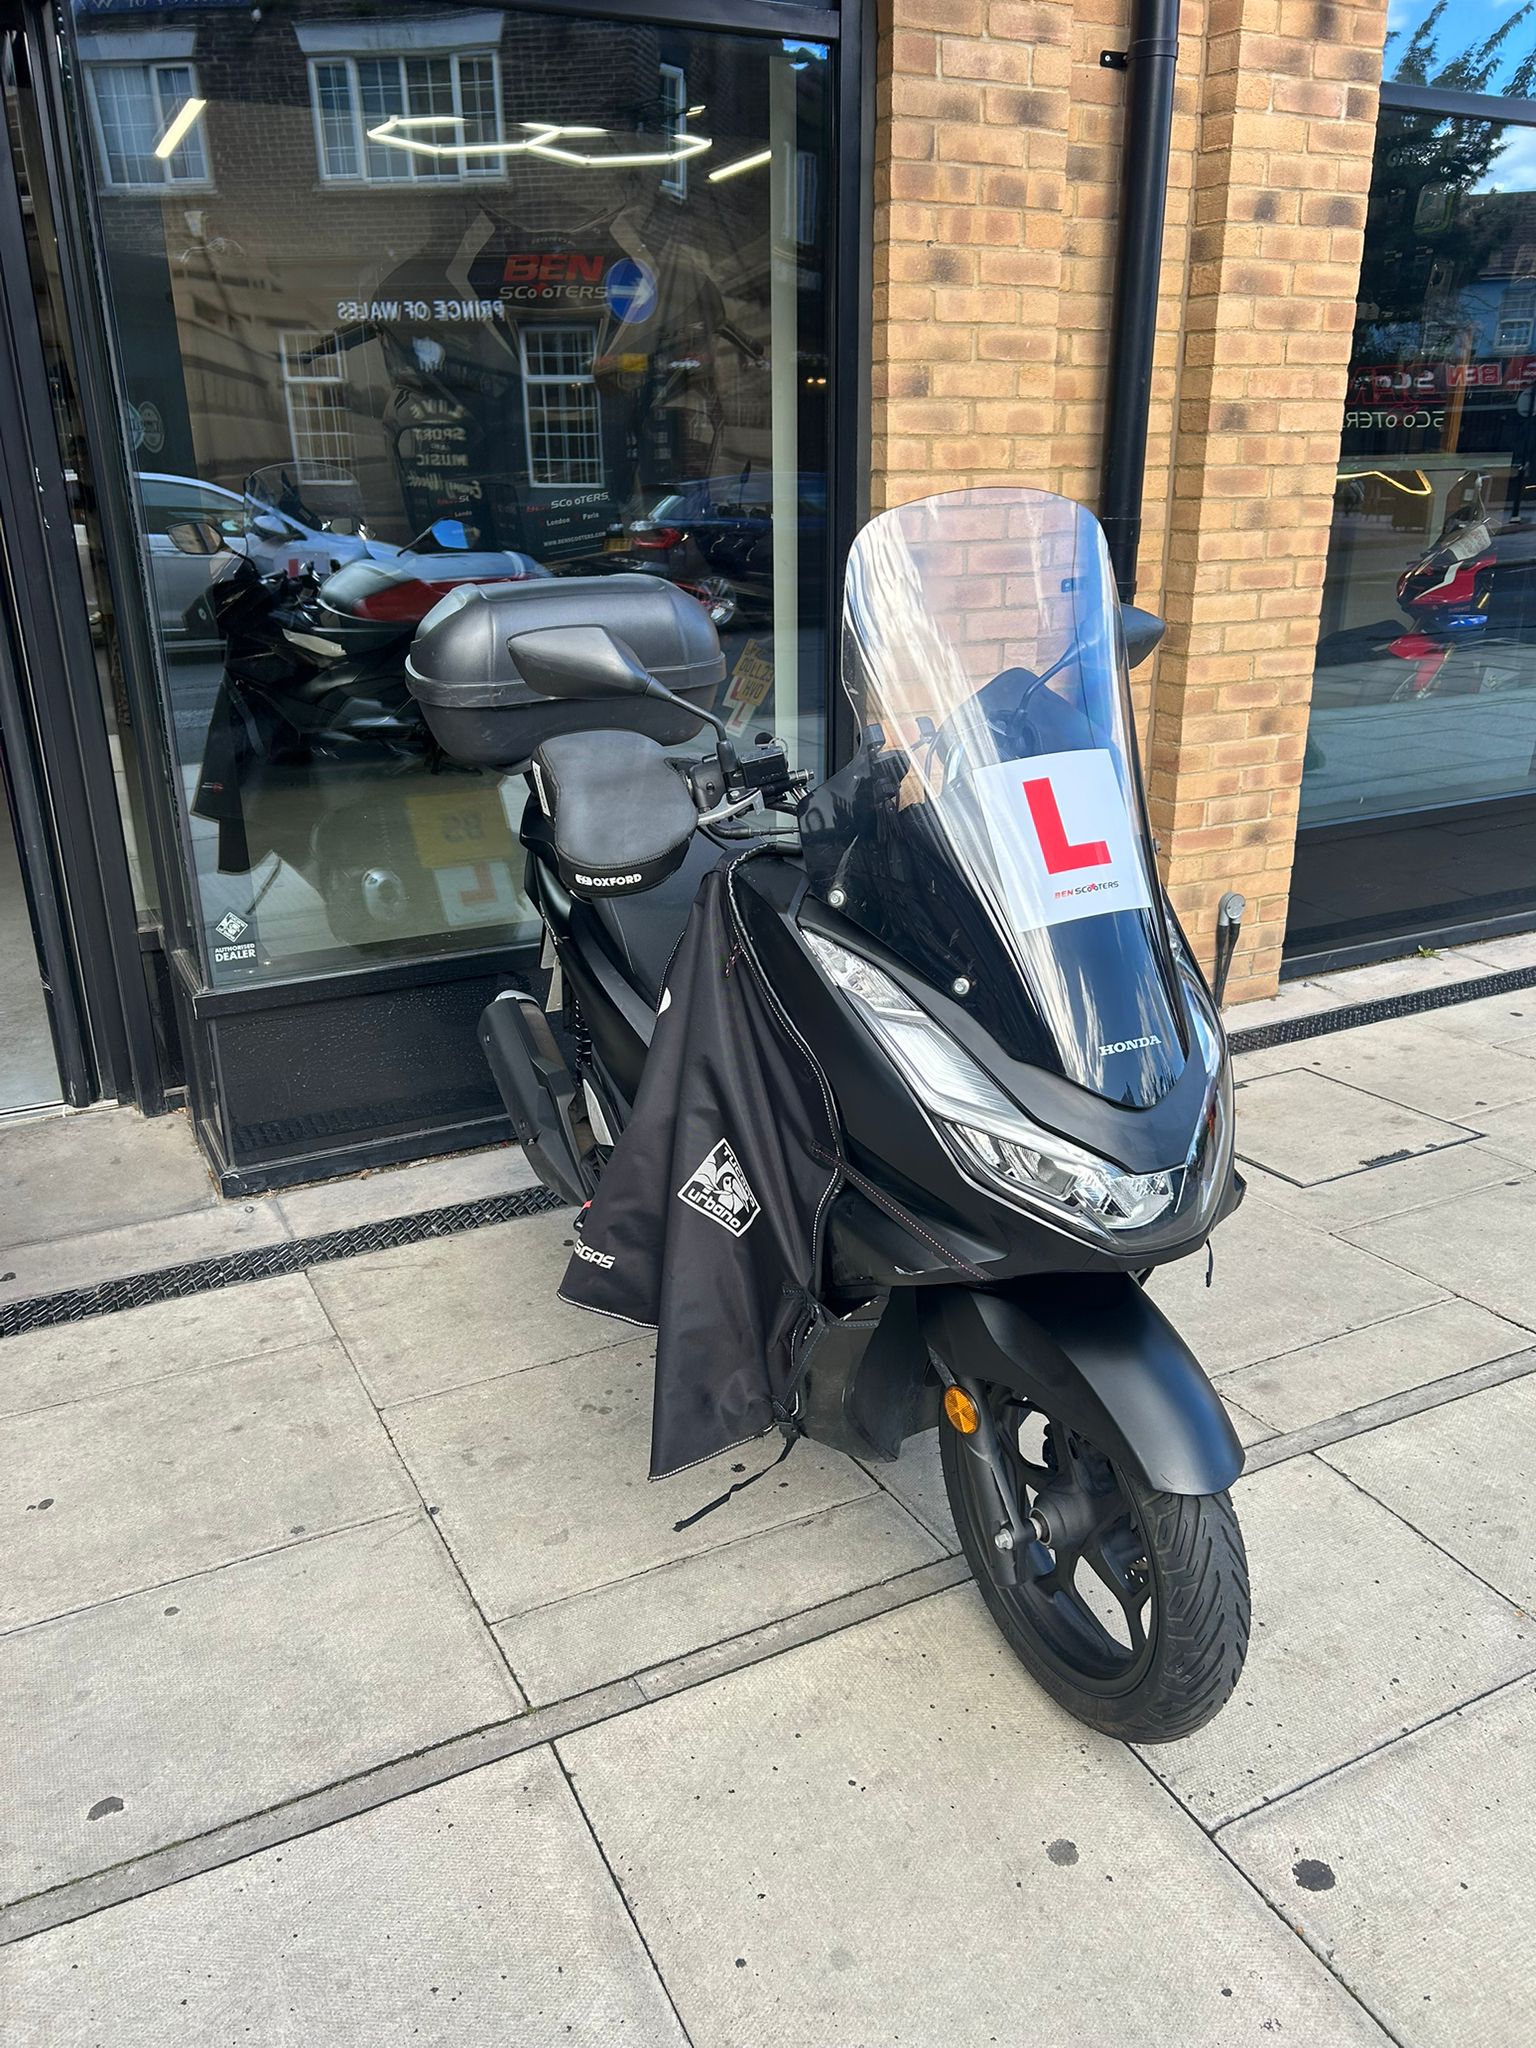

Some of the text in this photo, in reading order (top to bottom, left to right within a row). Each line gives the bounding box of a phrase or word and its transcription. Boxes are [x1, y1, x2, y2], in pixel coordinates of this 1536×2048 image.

[504, 254, 605, 282] BEN
[1023, 777, 1112, 875] L
[593, 873, 642, 887] OXFORD
[1055, 889, 1074, 899] BEN
[215, 949, 256, 962] DEALER
[1099, 1035, 1161, 1056] HONDA
